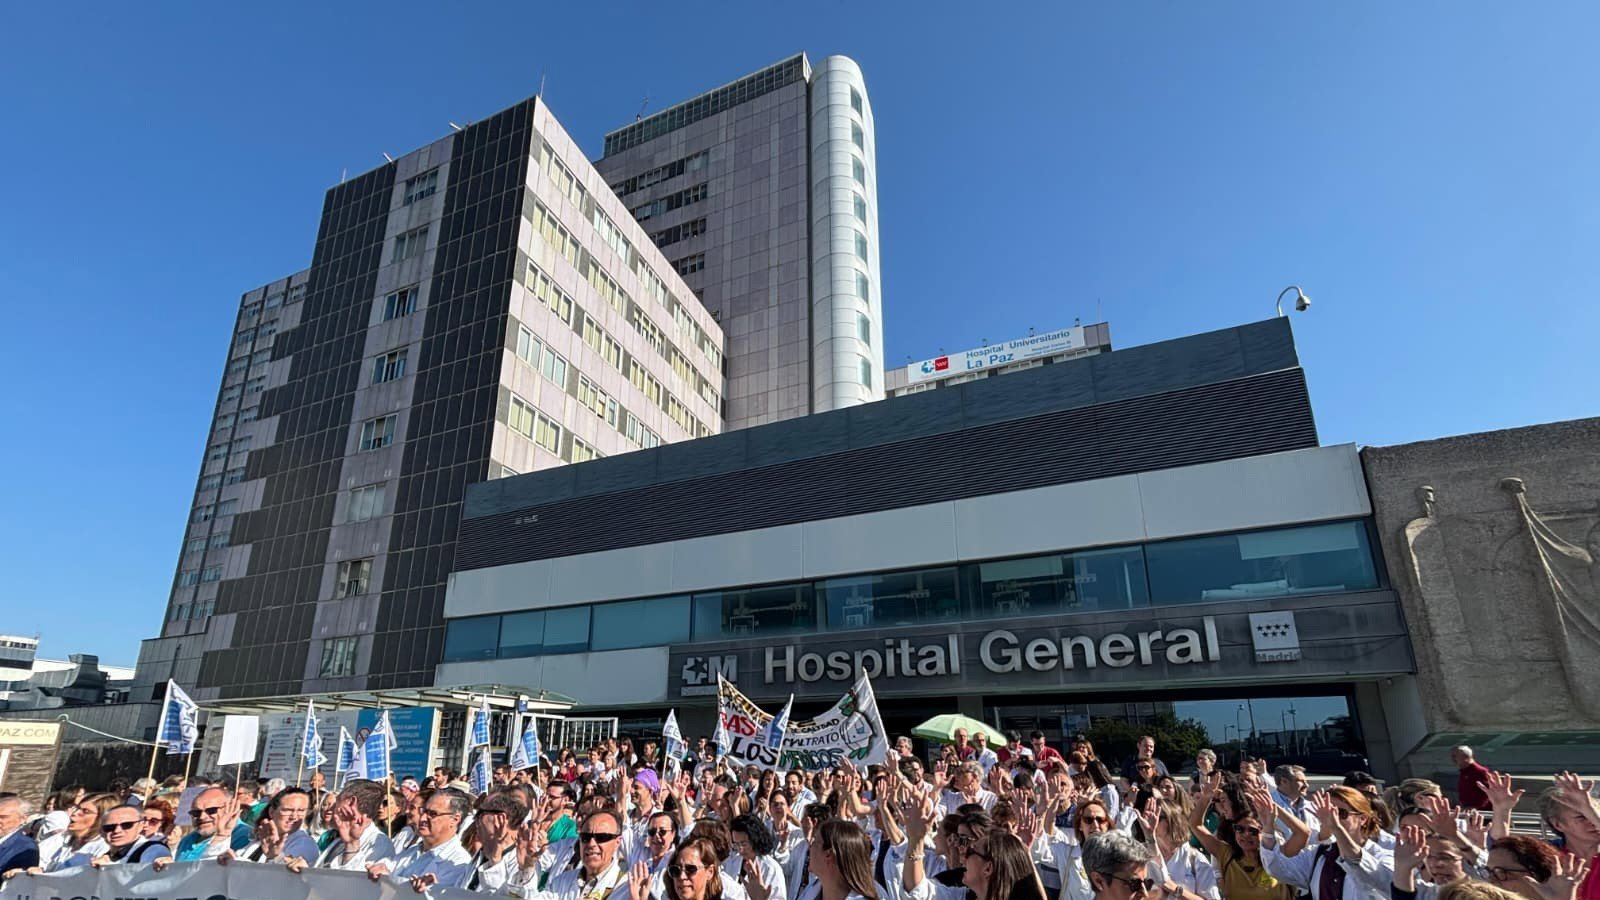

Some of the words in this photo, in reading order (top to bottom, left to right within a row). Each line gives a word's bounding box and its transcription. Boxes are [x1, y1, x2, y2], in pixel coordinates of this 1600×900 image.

[966, 343, 1004, 358] Hospital
[1010, 331, 1070, 349] Universitario
[967, 360, 983, 369] La
[990, 353, 1014, 364] Paz
[764, 634, 960, 684] Hospital
[979, 616, 1221, 673] General
[728, 736, 777, 765] LOS
